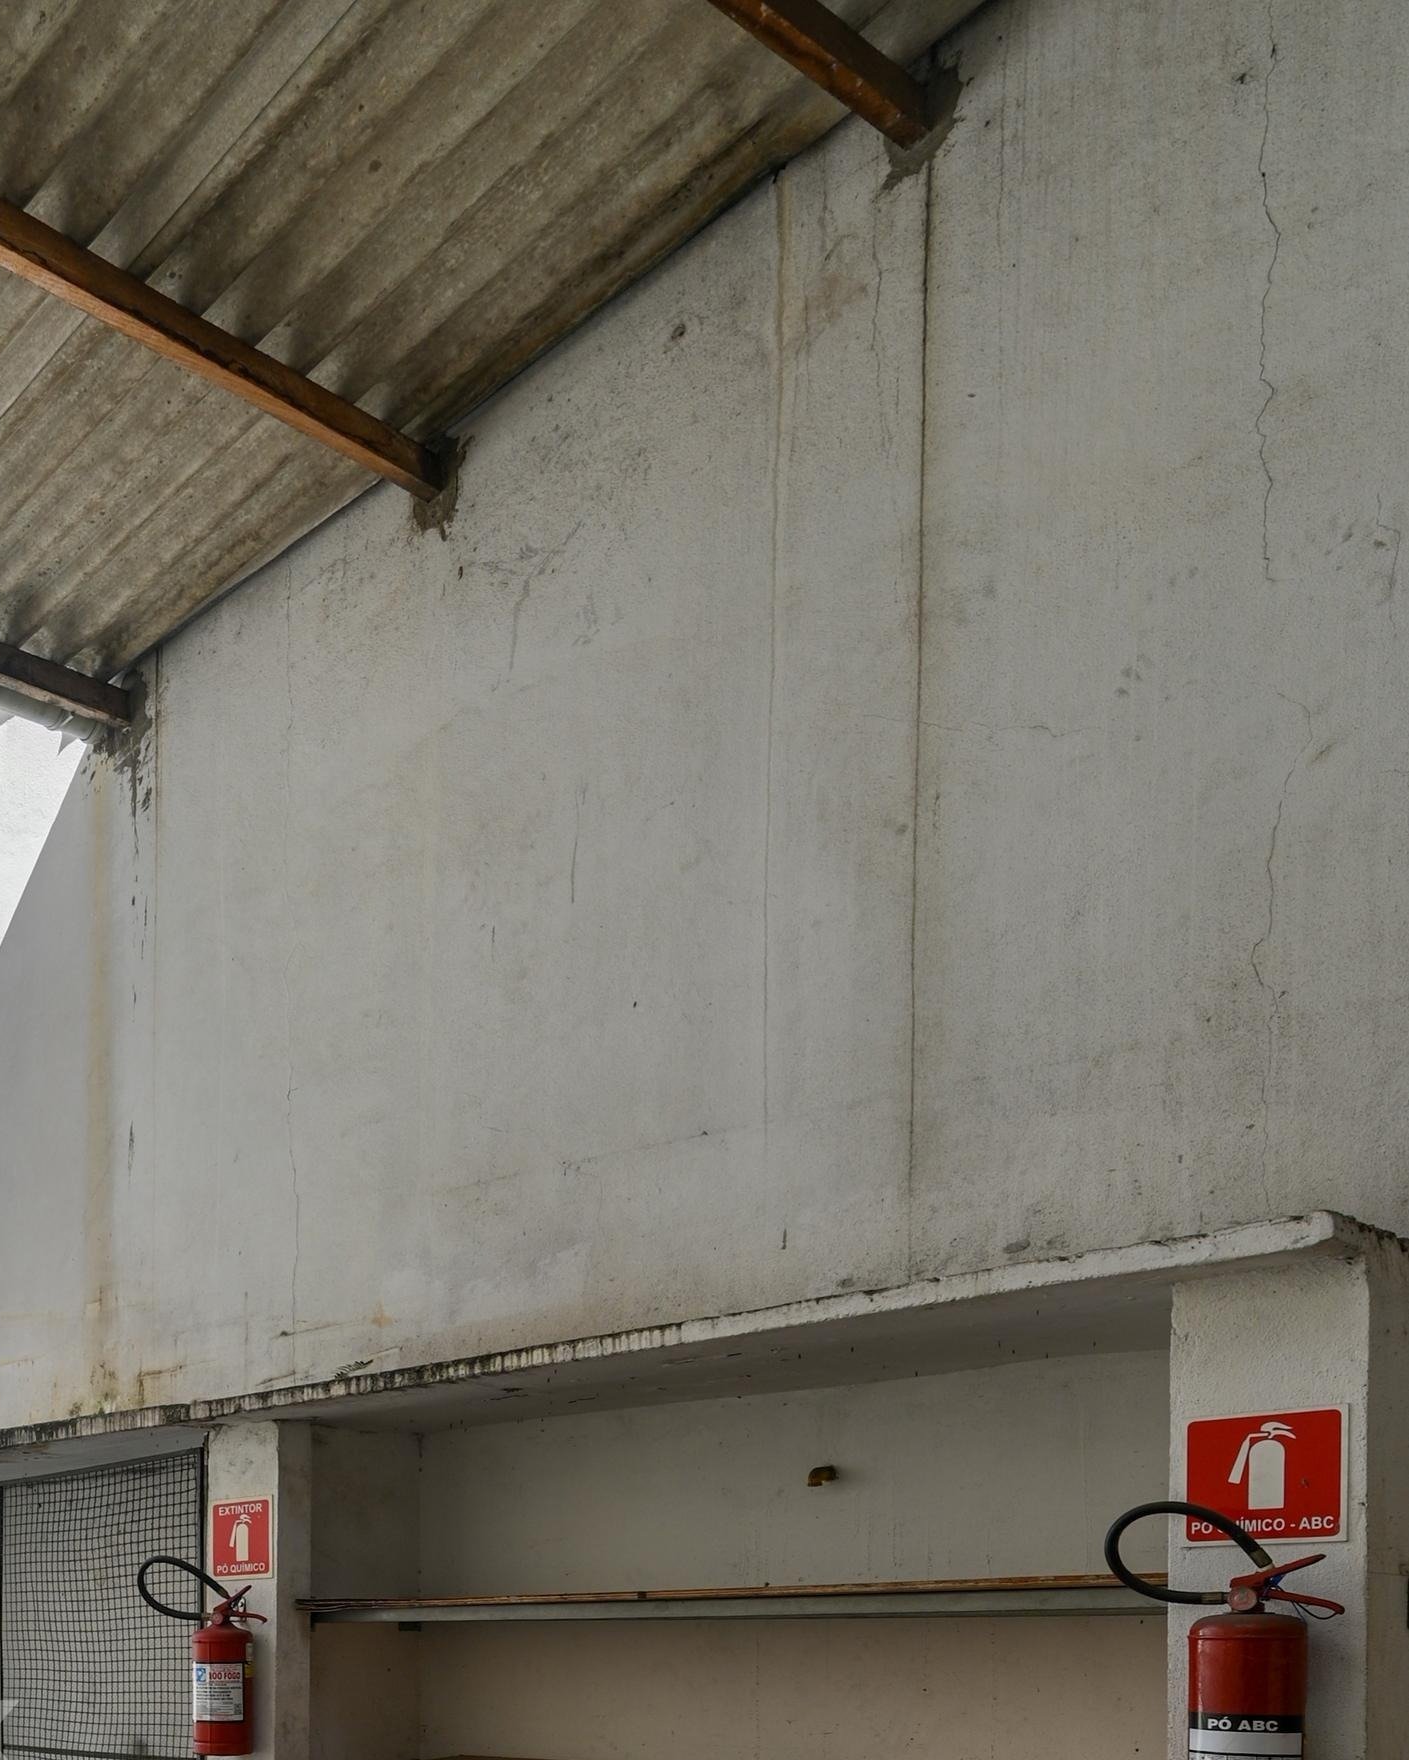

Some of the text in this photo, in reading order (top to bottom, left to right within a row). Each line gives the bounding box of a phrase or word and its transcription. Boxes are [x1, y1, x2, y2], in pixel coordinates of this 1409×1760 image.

[219, 1503, 262, 1516] EXTINTOR
[1299, 1516, 1334, 1530] ABC
[217, 1562, 265, 1574] PÓ QUÍMICO
[1207, 1716, 1279, 1732] PÓ ABC
